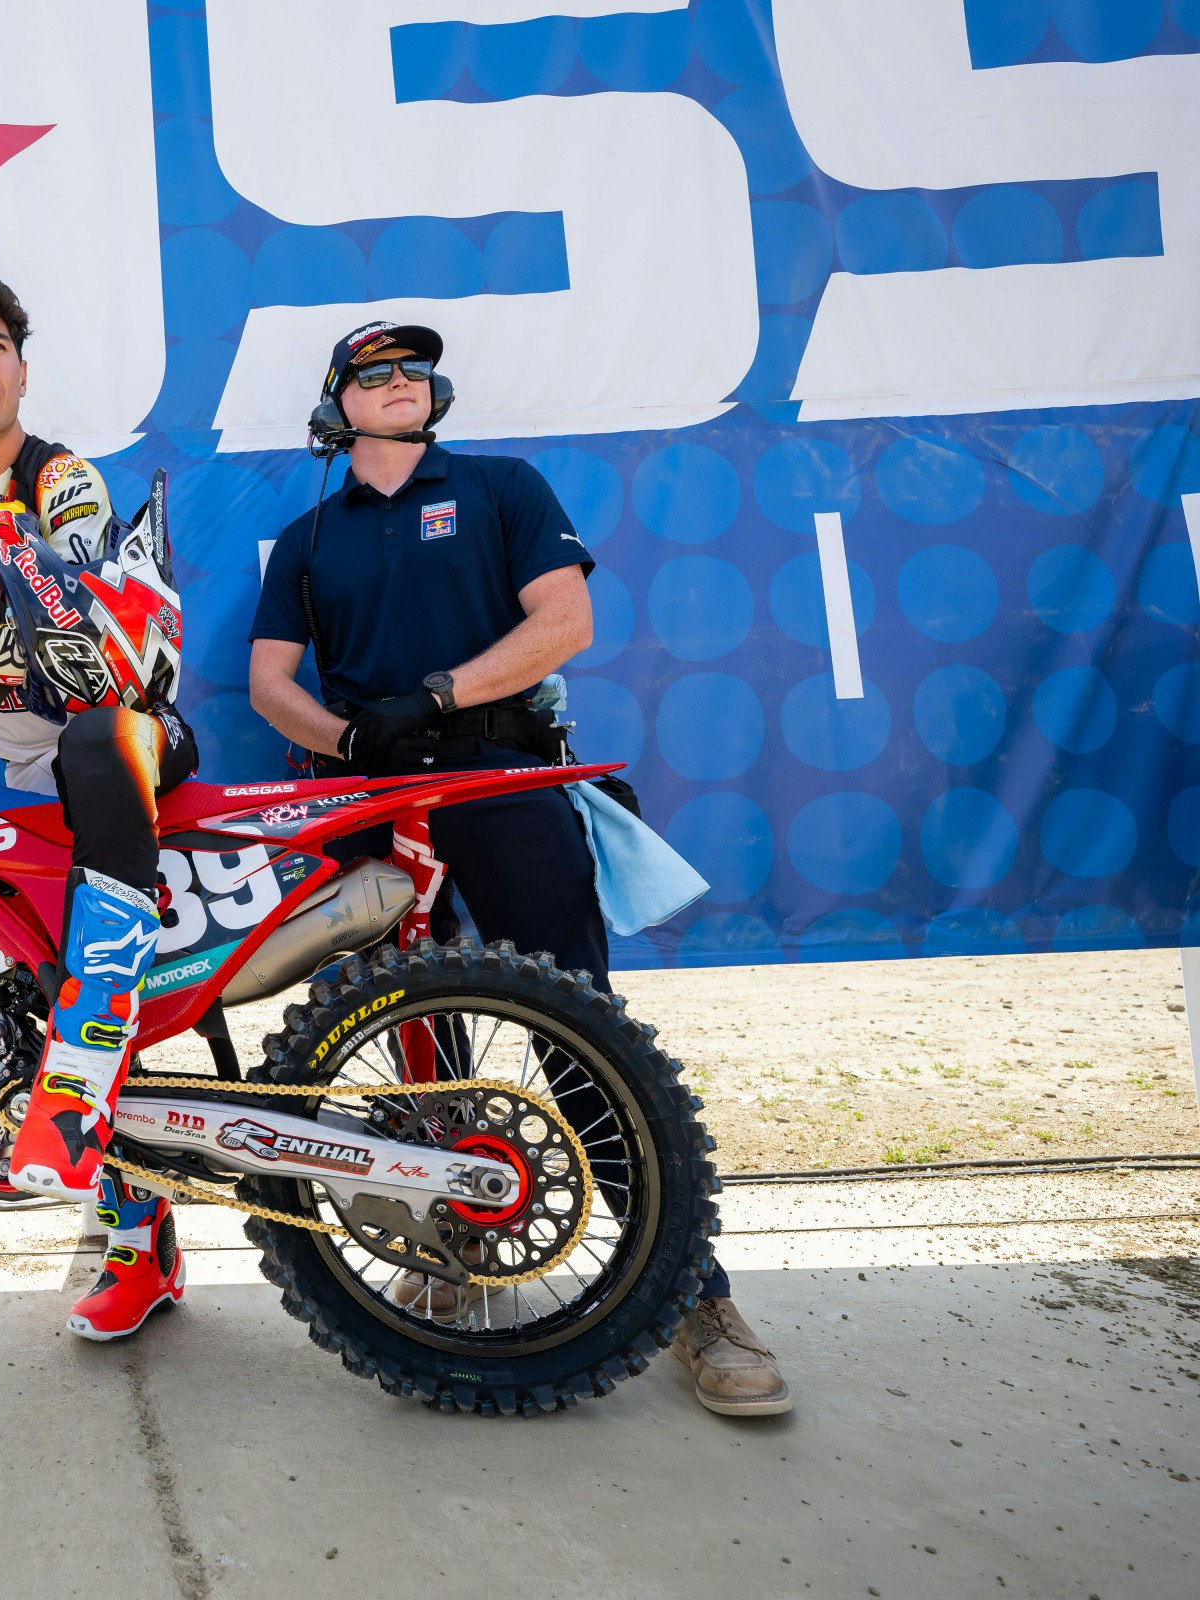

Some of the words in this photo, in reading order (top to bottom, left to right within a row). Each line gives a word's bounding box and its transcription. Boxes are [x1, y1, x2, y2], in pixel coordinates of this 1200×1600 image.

[225, 784, 295, 797] GASGAS
[145, 958, 212, 990] MOTOREX
[315, 989, 406, 1062] DUNLOP
[116, 1109, 156, 1125] brembo
[221, 1119, 372, 1166] RENTHAL
